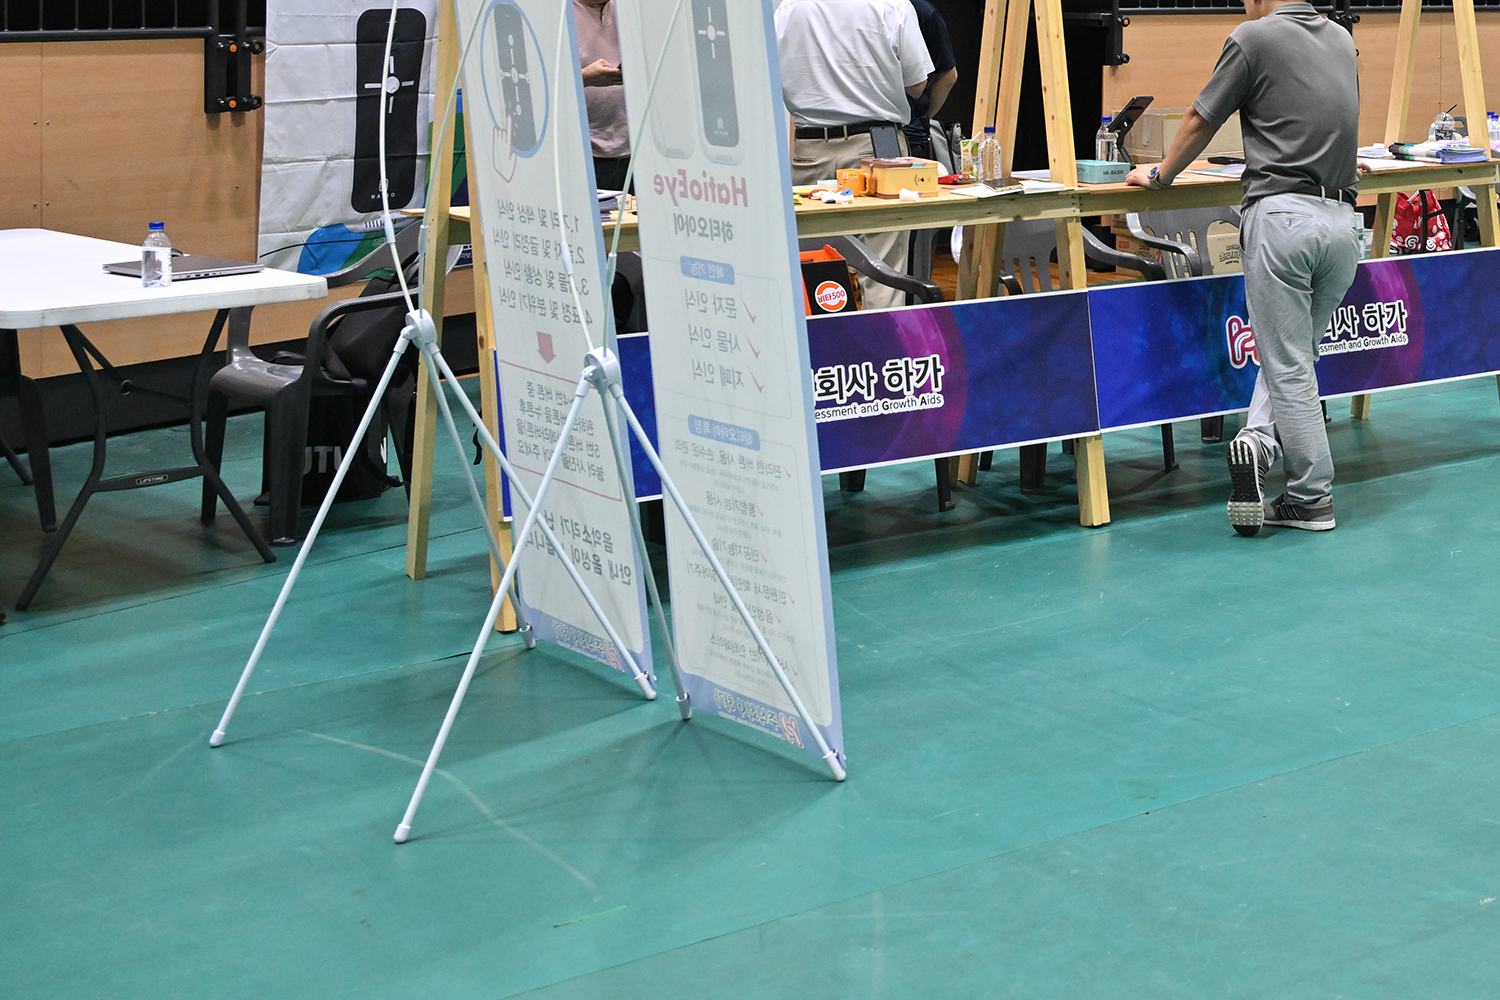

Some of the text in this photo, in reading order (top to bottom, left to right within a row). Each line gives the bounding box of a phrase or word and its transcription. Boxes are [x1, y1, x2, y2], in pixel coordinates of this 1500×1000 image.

[817, 290, 845, 303] 비타500
[1364, 302, 1406, 332] 하가
[1318, 334, 1407, 353] ssment and Growth Aids
[814, 356, 942, 400] 회사 하가
[815, 395, 941, 419] essment and Growth Aids
